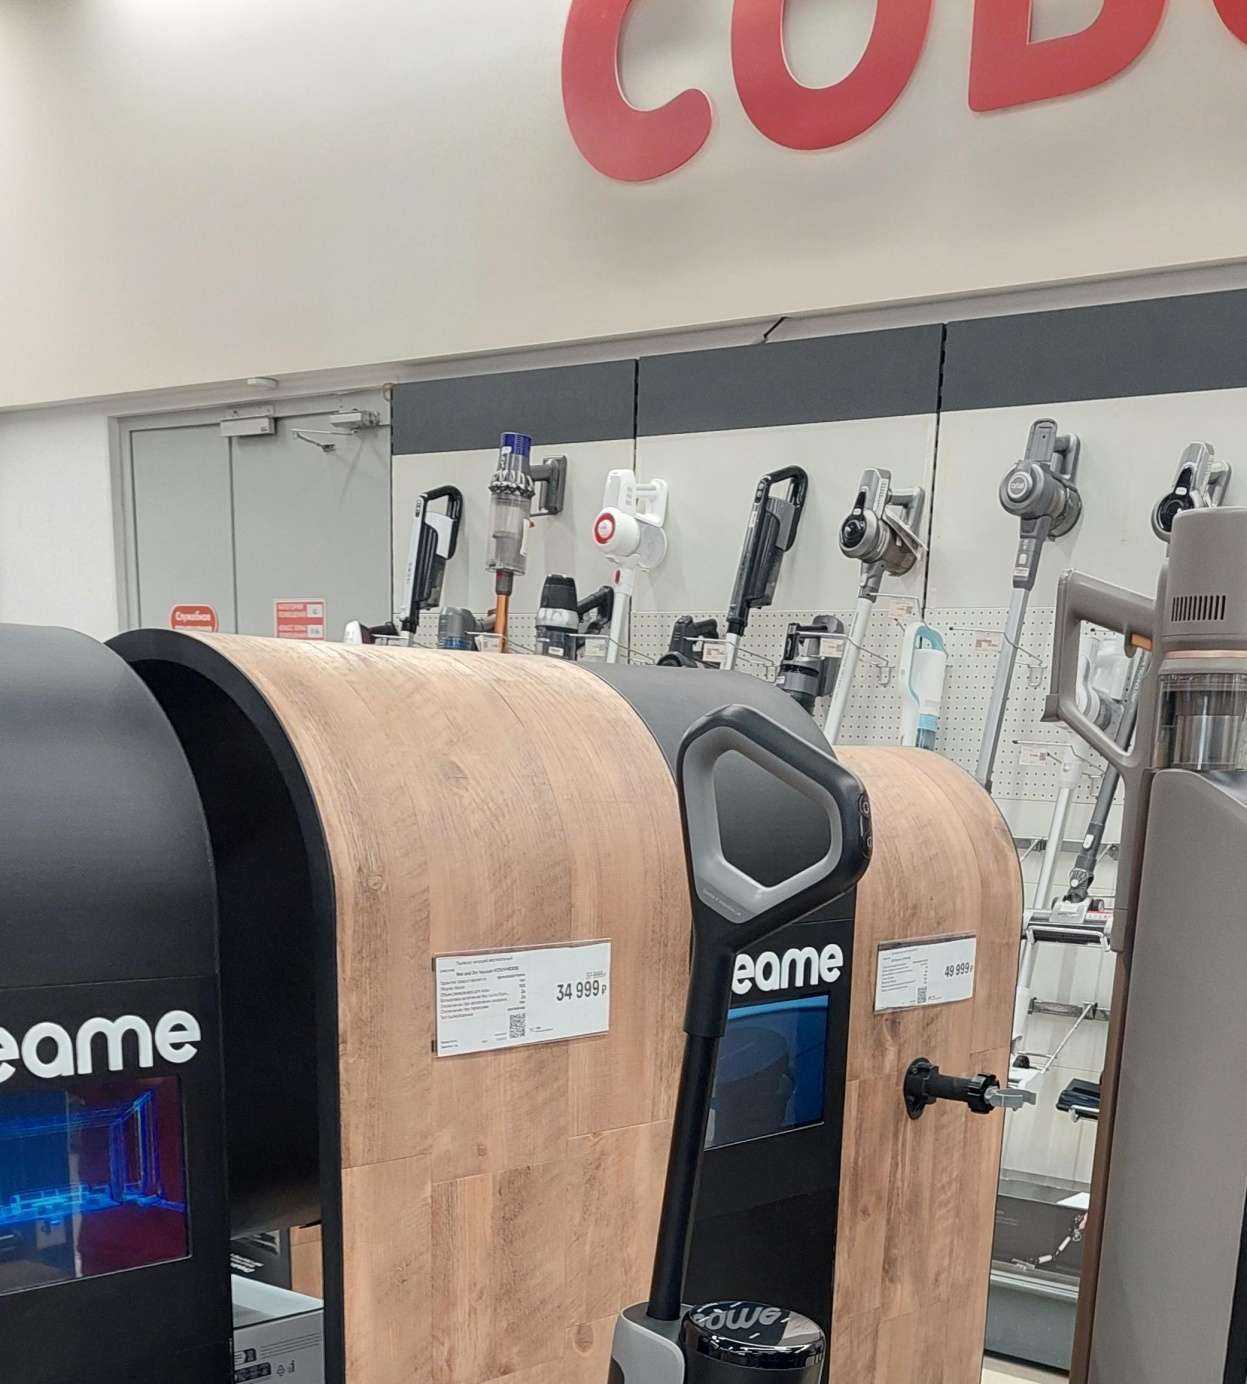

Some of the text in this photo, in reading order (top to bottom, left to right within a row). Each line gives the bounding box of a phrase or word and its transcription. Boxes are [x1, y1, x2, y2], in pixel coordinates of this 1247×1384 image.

[944, 964, 955, 978] 49
[956, 961, 969, 976] 999
[557, 983, 572, 1001] 34
[576, 980, 600, 998] 999
